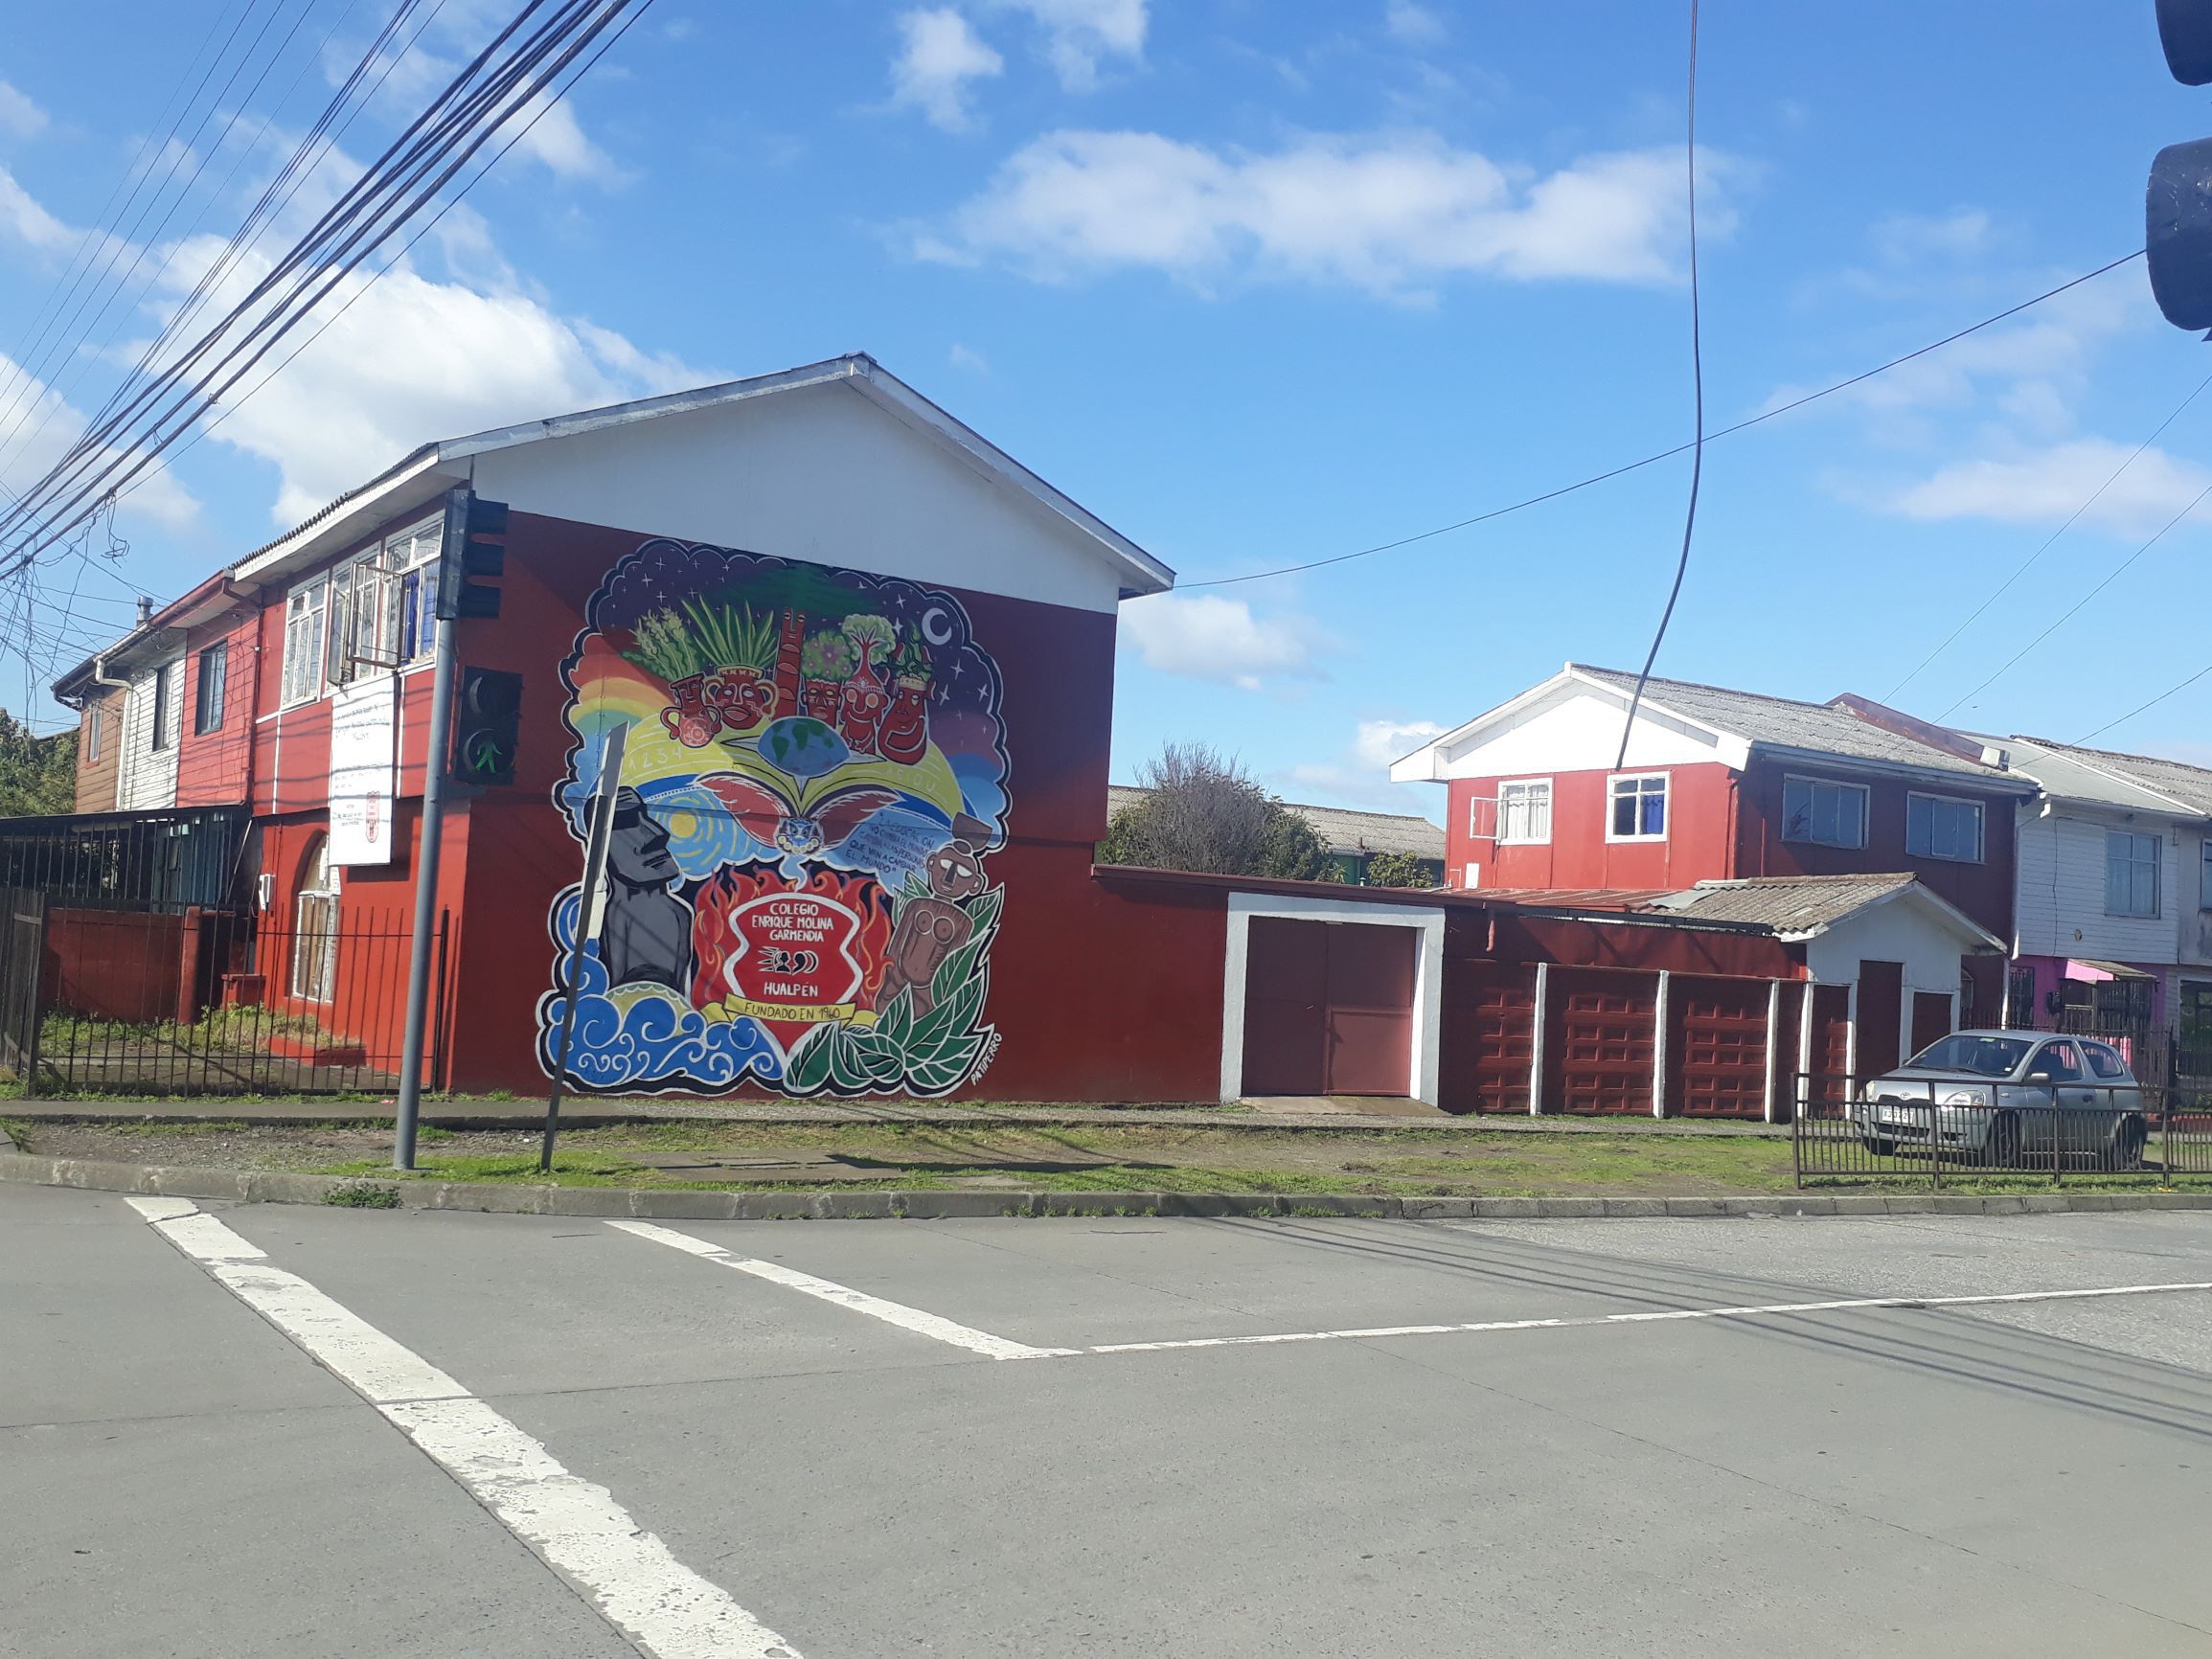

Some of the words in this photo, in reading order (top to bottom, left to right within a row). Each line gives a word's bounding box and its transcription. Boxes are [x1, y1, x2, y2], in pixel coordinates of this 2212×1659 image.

[845, 849, 855, 860] EL
[769, 902, 819, 916] COLEGIO
[752, 915, 794, 929] ENRIQUE
[797, 917, 834, 931] MOLINA
[769, 929, 824, 943] GARMENDIA
[764, 981, 818, 997] HUALPÉN
[744, 1002, 797, 1019] FUNDADO
[799, 1007, 814, 1020] EN
[819, 1006, 841, 1020] 1960
[970, 1033, 1003, 1086] PATIPERRO
